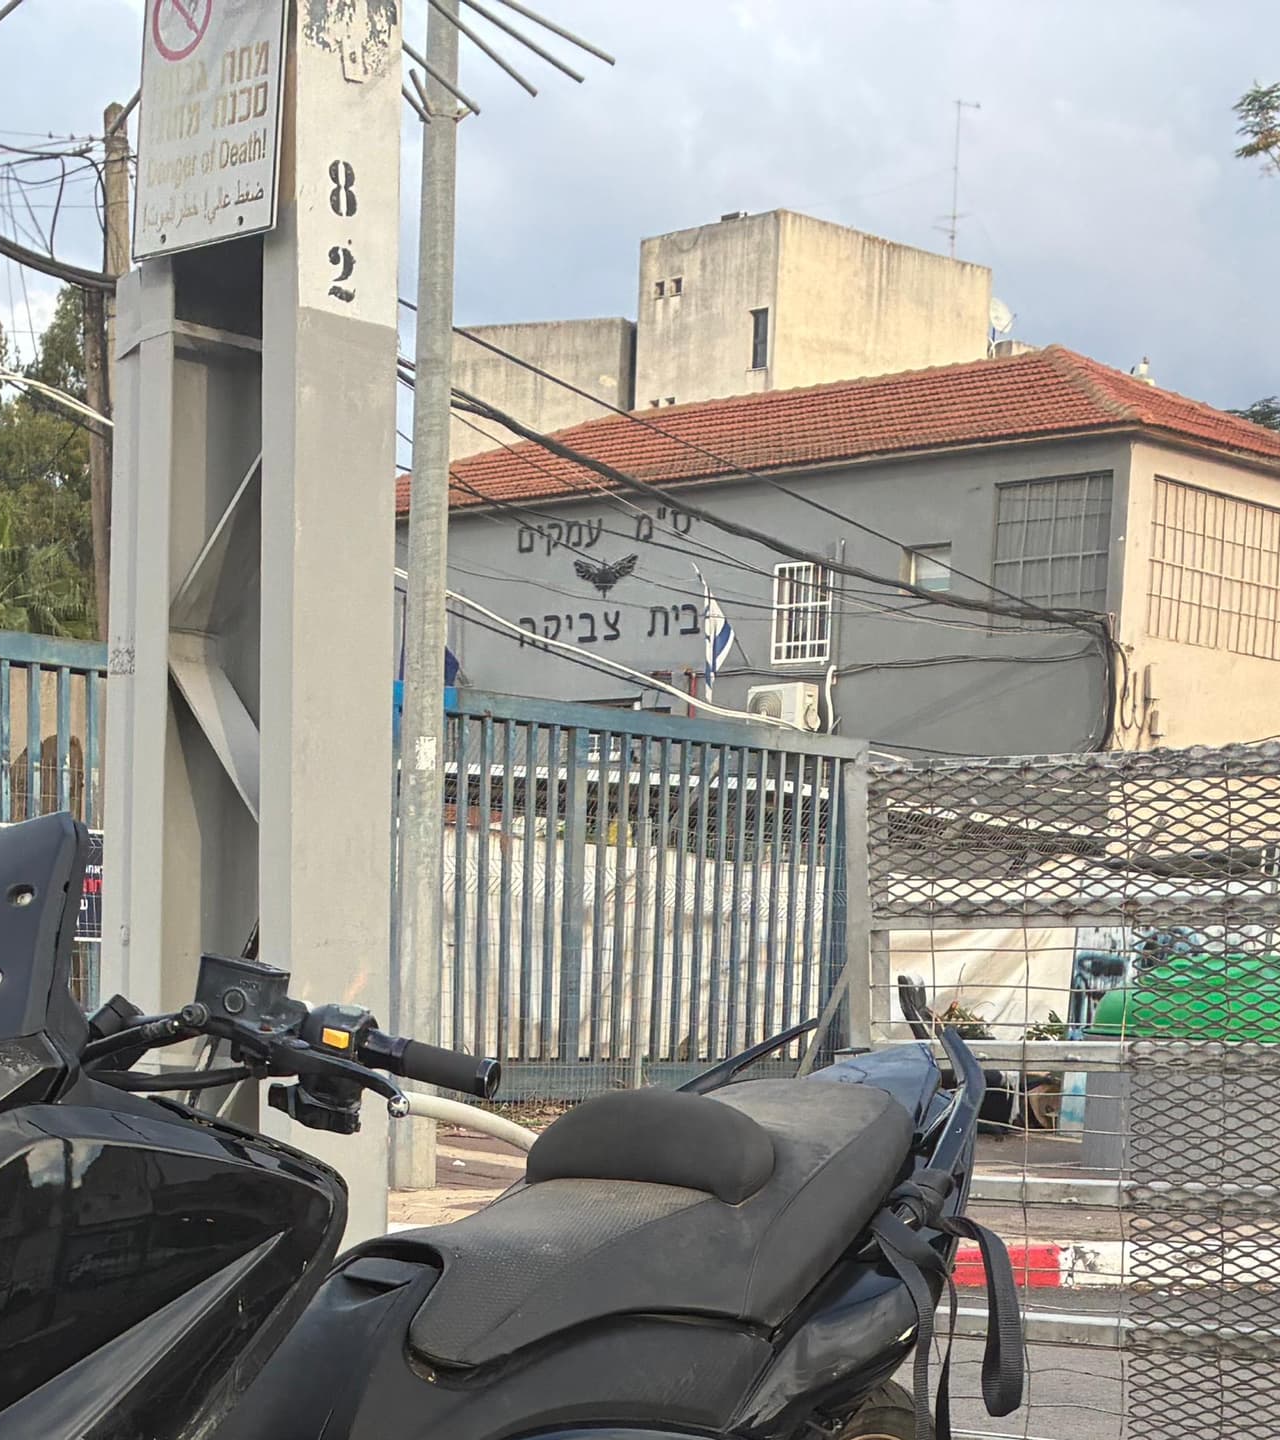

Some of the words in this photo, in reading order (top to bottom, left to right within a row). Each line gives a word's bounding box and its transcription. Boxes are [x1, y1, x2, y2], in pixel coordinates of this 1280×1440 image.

[220, 127, 267, 169] Death!
[518, 517, 603, 557] עמקים
[519, 609, 621, 648] צביקה
[647, 603, 701, 638] בית
